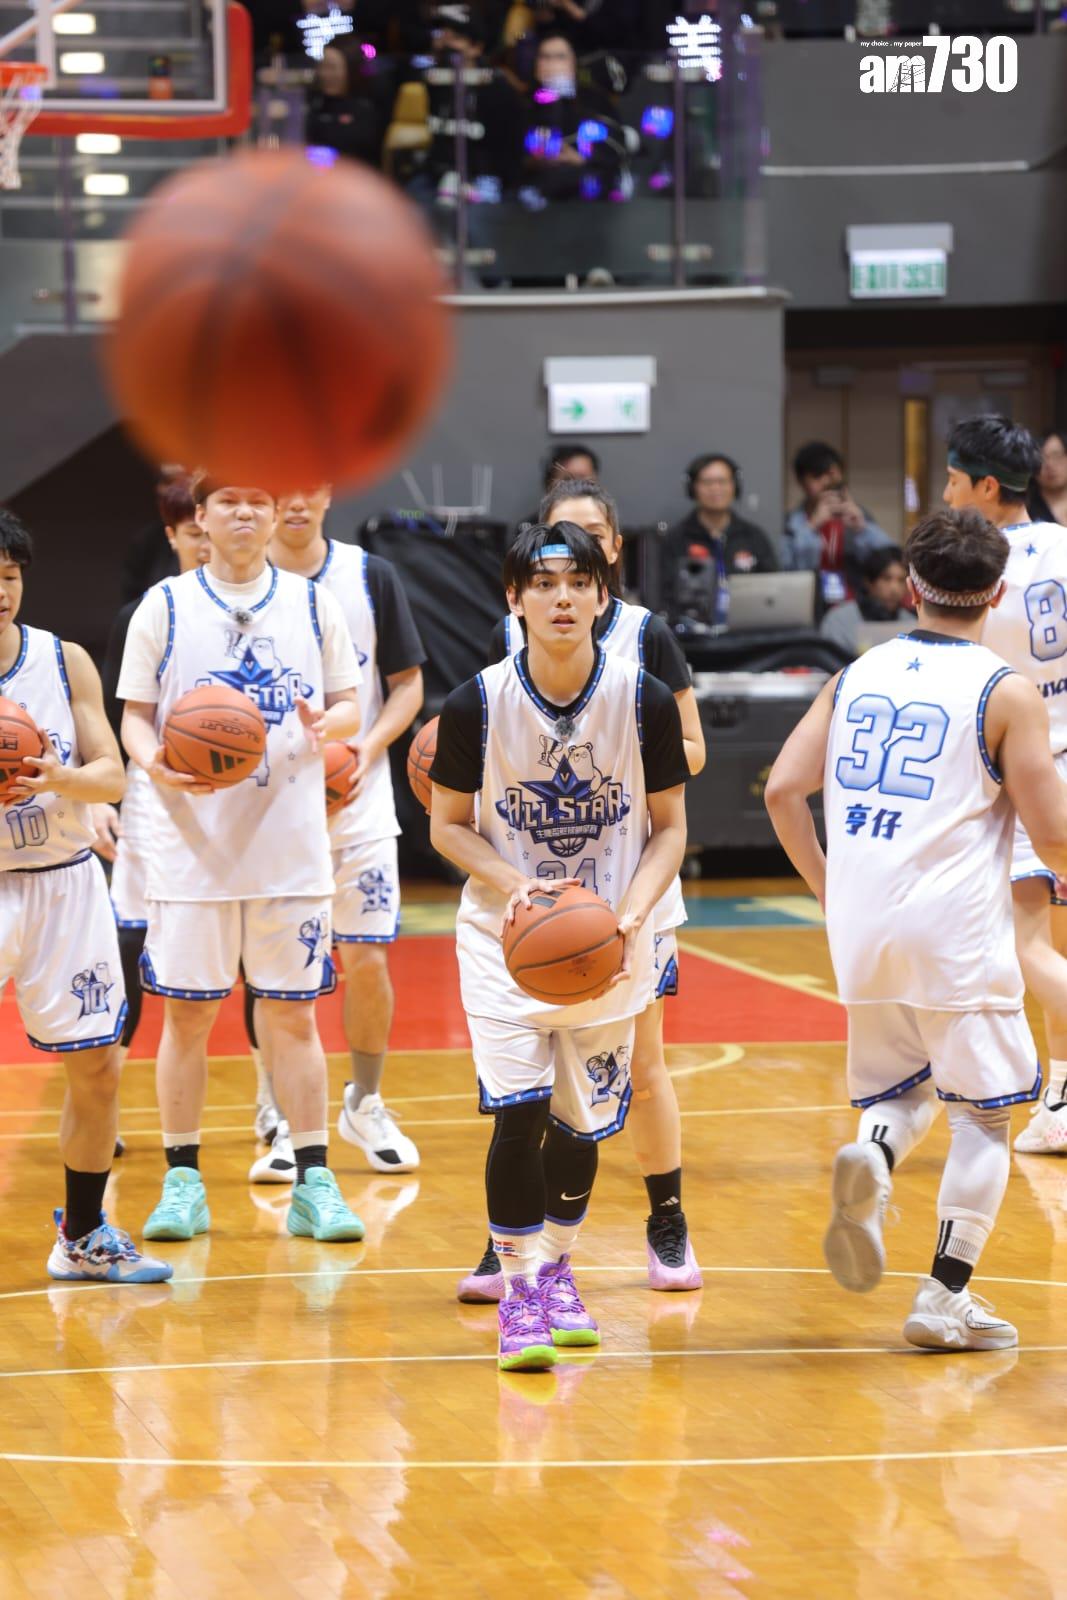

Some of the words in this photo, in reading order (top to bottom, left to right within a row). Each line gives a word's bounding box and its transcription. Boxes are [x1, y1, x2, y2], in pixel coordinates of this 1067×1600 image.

[835, 693, 950, 800] 32
[5, 805, 48, 849] 10
[505, 787, 554, 831] ALL
[557, 782, 623, 826] STAR
[82, 981, 107, 1015] 10
